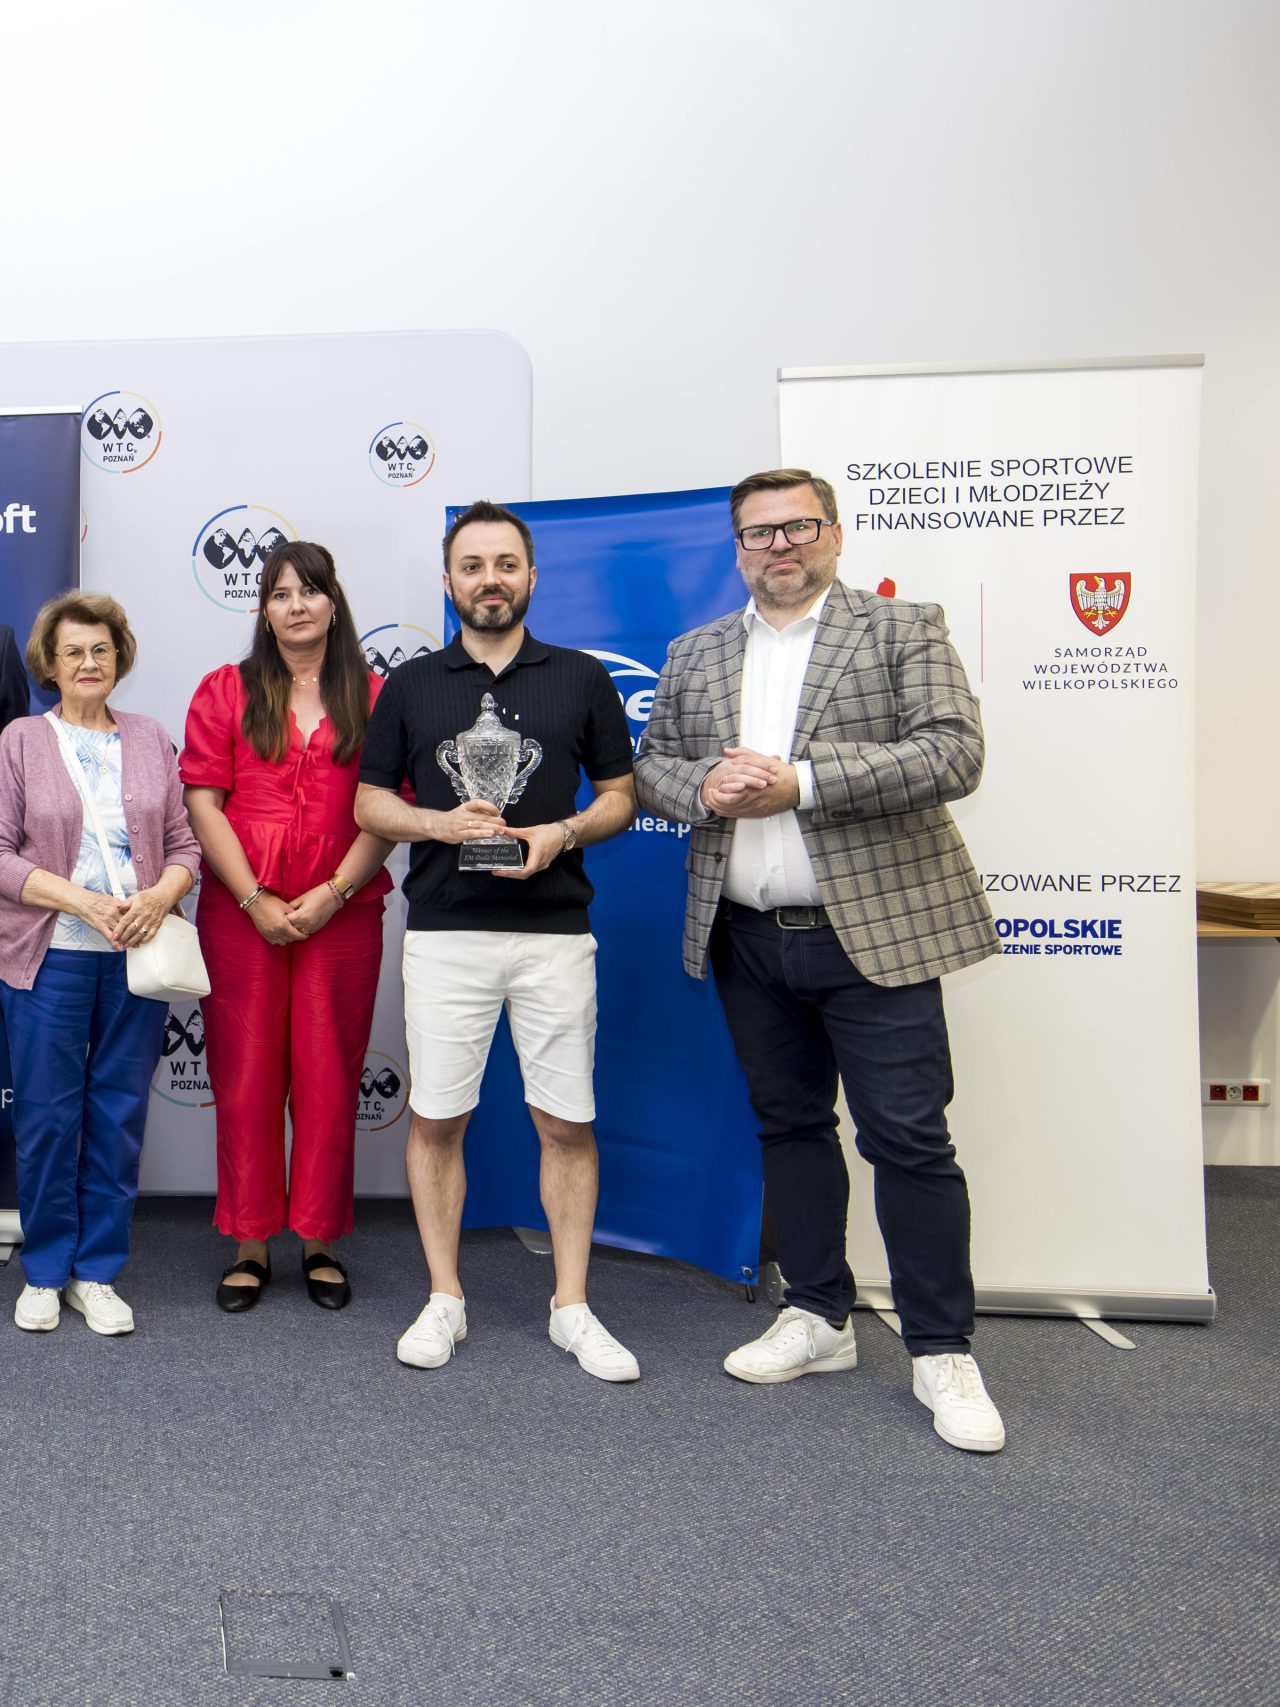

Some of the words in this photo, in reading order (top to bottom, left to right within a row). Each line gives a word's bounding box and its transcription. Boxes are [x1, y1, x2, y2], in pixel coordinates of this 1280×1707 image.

[103, 453, 134, 462] POZNAŃ
[847, 461, 981, 481] SZKOLENIE
[990, 456, 1133, 477] SPORTOWE
[869, 487, 946, 506] DZIECI
[970, 480, 1110, 503] MŁODZIEŻY
[856, 510, 1034, 530] FINANSOWANE
[1043, 507, 1125, 527] PRZEZ
[224, 590, 258, 599] POZNA
[1054, 647, 1147, 659] SAMORZĄD
[1034, 661, 1168, 674] WOJEWÓDZTWA
[1023, 678, 1178, 690] WIELKOPOLSKIEGO
[980, 874, 1092, 892] IZOWANE
[1101, 875, 1181, 893] PRZEZ
[993, 919, 1123, 939] OPOLSKIE
[1045, 944, 1123, 956] SPORTOWE
[170, 1080, 210, 1090] POZNA
[355, 1112, 382, 1120] OZNAŃ
